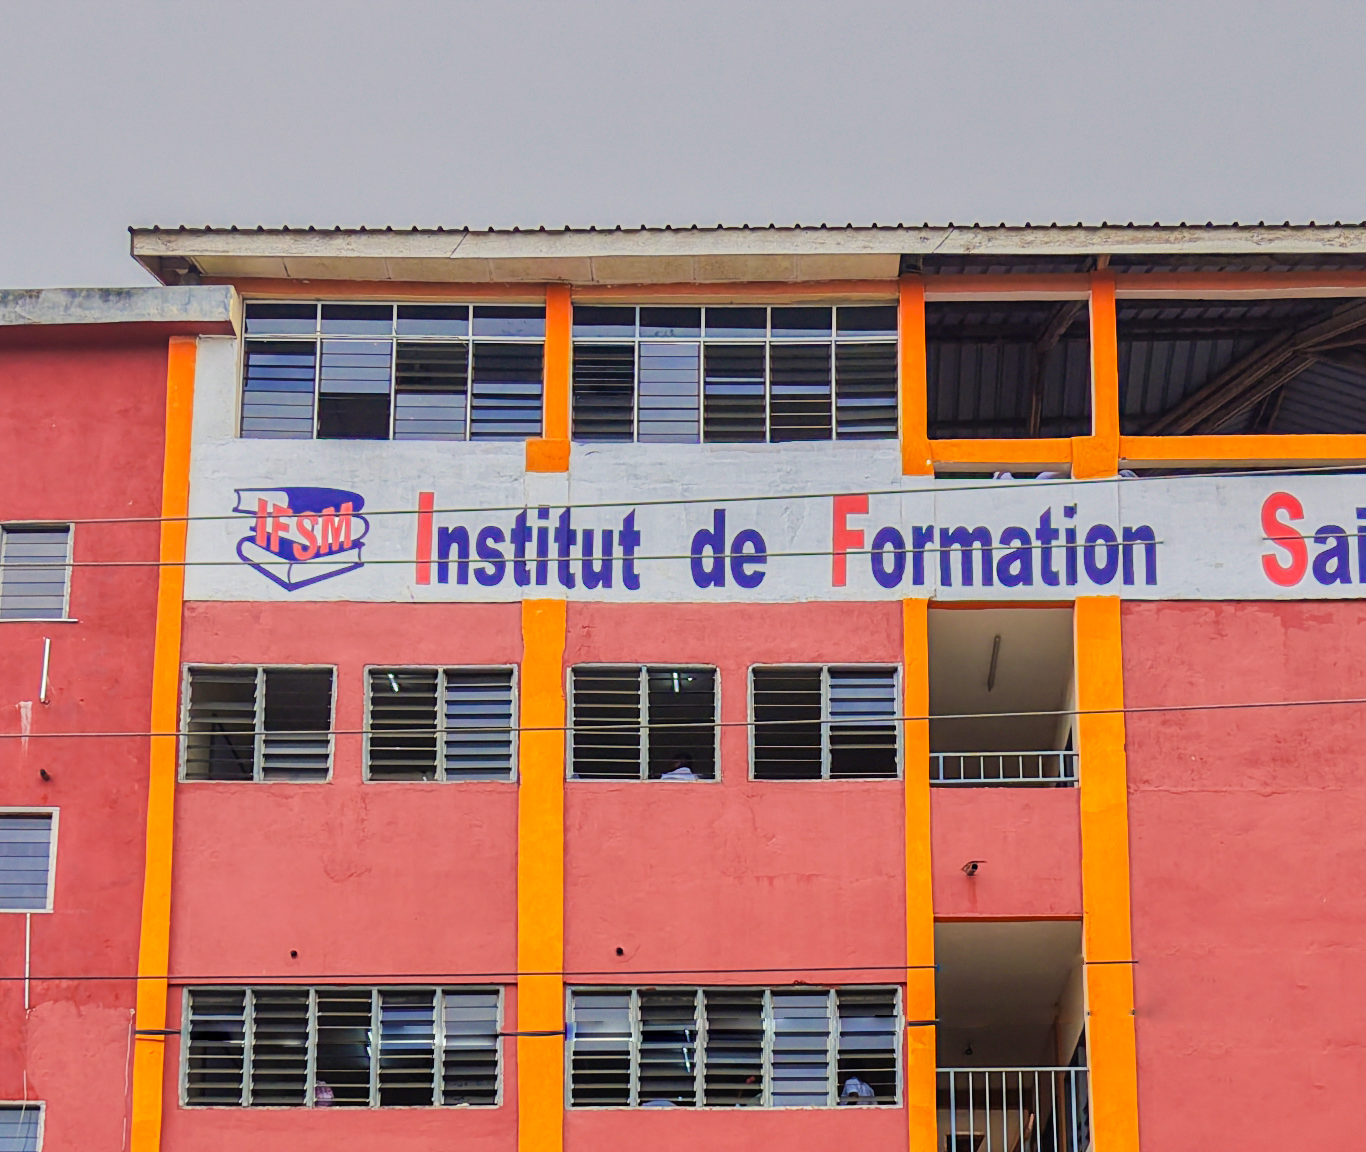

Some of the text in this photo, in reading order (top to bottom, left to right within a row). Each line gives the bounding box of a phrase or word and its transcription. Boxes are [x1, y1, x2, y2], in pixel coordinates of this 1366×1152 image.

[252, 497, 354, 562] IFSM
[415, 491, 641, 591] Institut
[690, 508, 768, 588] de
[831, 493, 1159, 590] Formation
